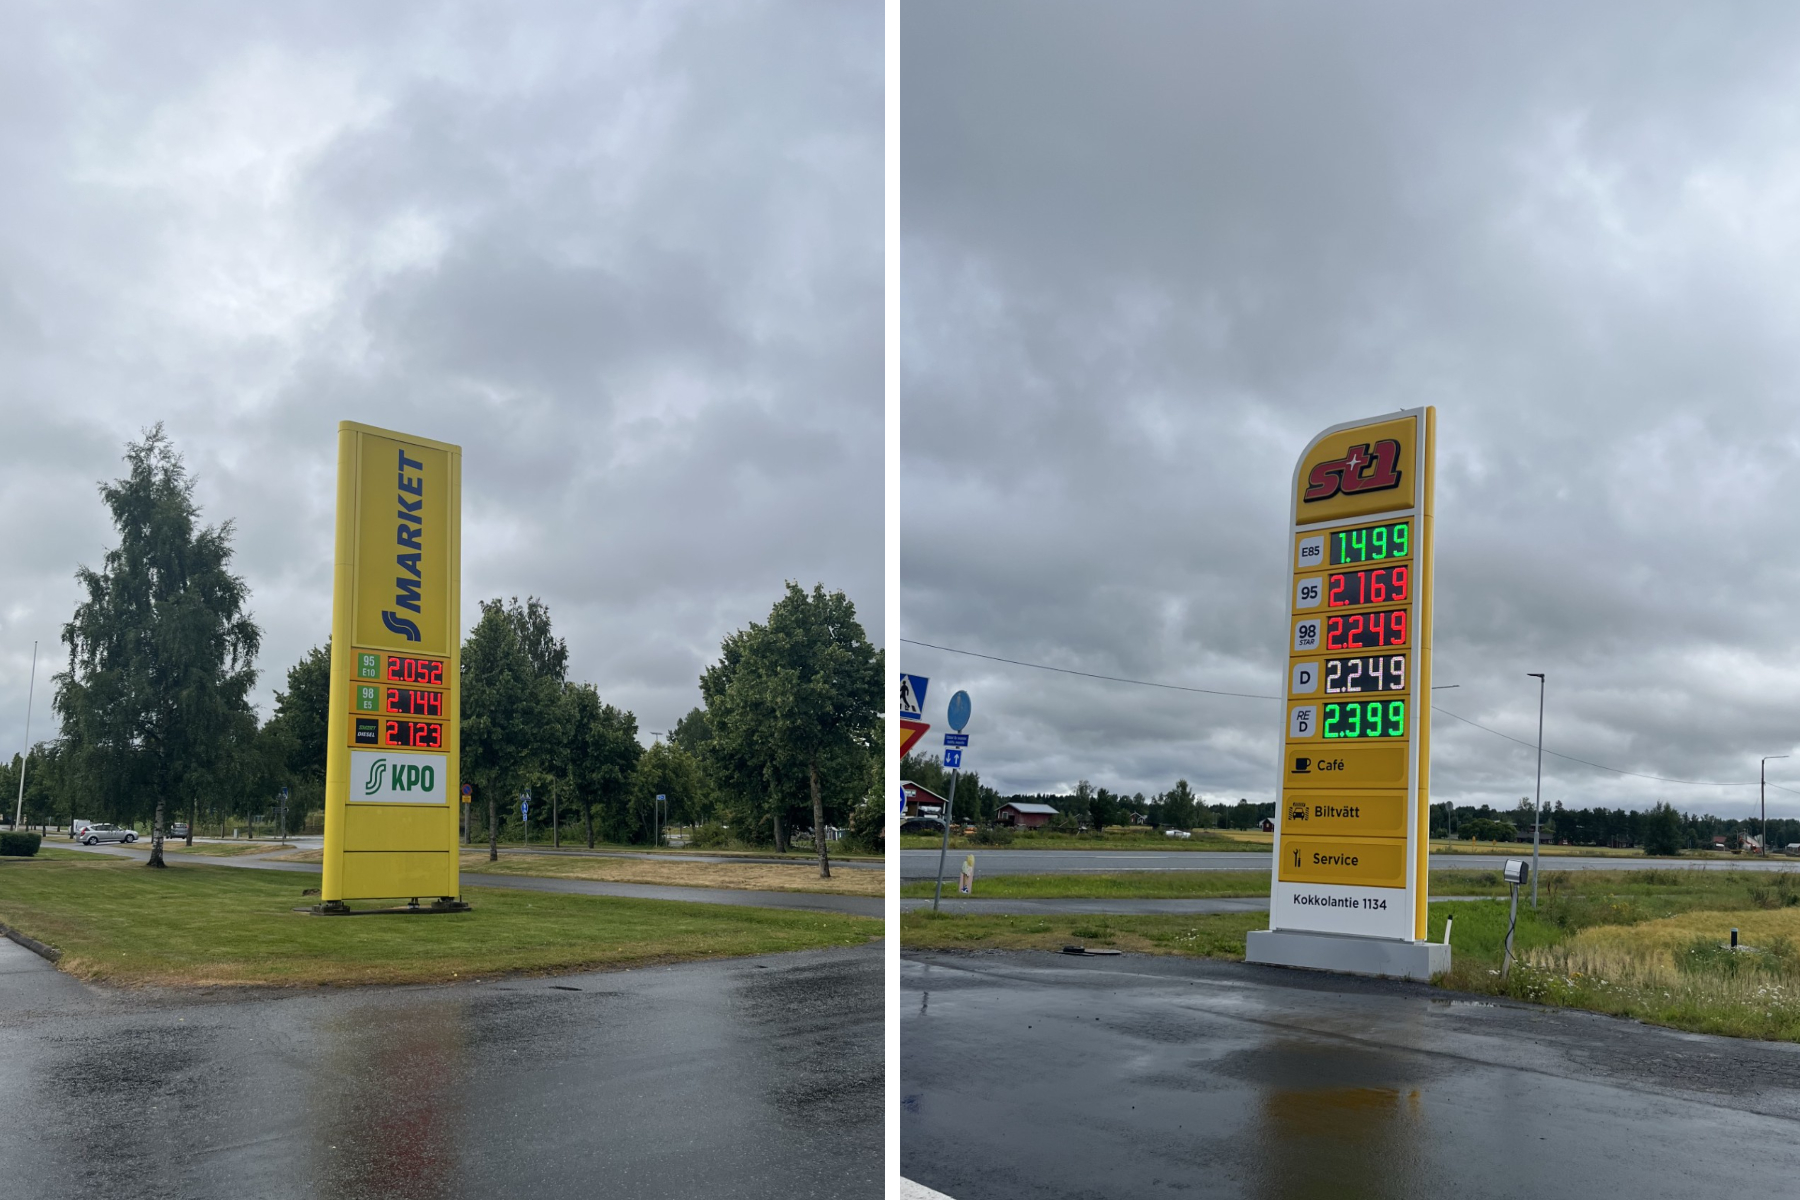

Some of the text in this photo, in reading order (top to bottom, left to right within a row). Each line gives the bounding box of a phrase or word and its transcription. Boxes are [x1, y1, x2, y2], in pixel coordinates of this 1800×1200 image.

[395, 448, 424, 614] MARKET
[1301, 523, 1409, 564] E85 1.499
[1301, 566, 1408, 607] 95 2.169
[1298, 610, 1406, 650] 98 2.249
[1298, 638, 1315, 646] STAR
[362, 667, 375, 678] E10
[363, 655, 443, 685] 95 2.052
[1300, 655, 1405, 693] D 2.249
[362, 687, 442, 716] 98 2.144
[363, 700, 373, 709] E5
[1296, 700, 1405, 738] RE 2.399
[1298, 721, 1308, 732] D
[385, 720, 441, 748] 2.123
[391, 763, 435, 793] KPO
[1317, 759, 1345, 771] Café
[1314, 805, 1360, 818] Biltvätt
[1313, 852, 1359, 866] Service
[1293, 893, 1387, 910] Kokkolantie 1134
